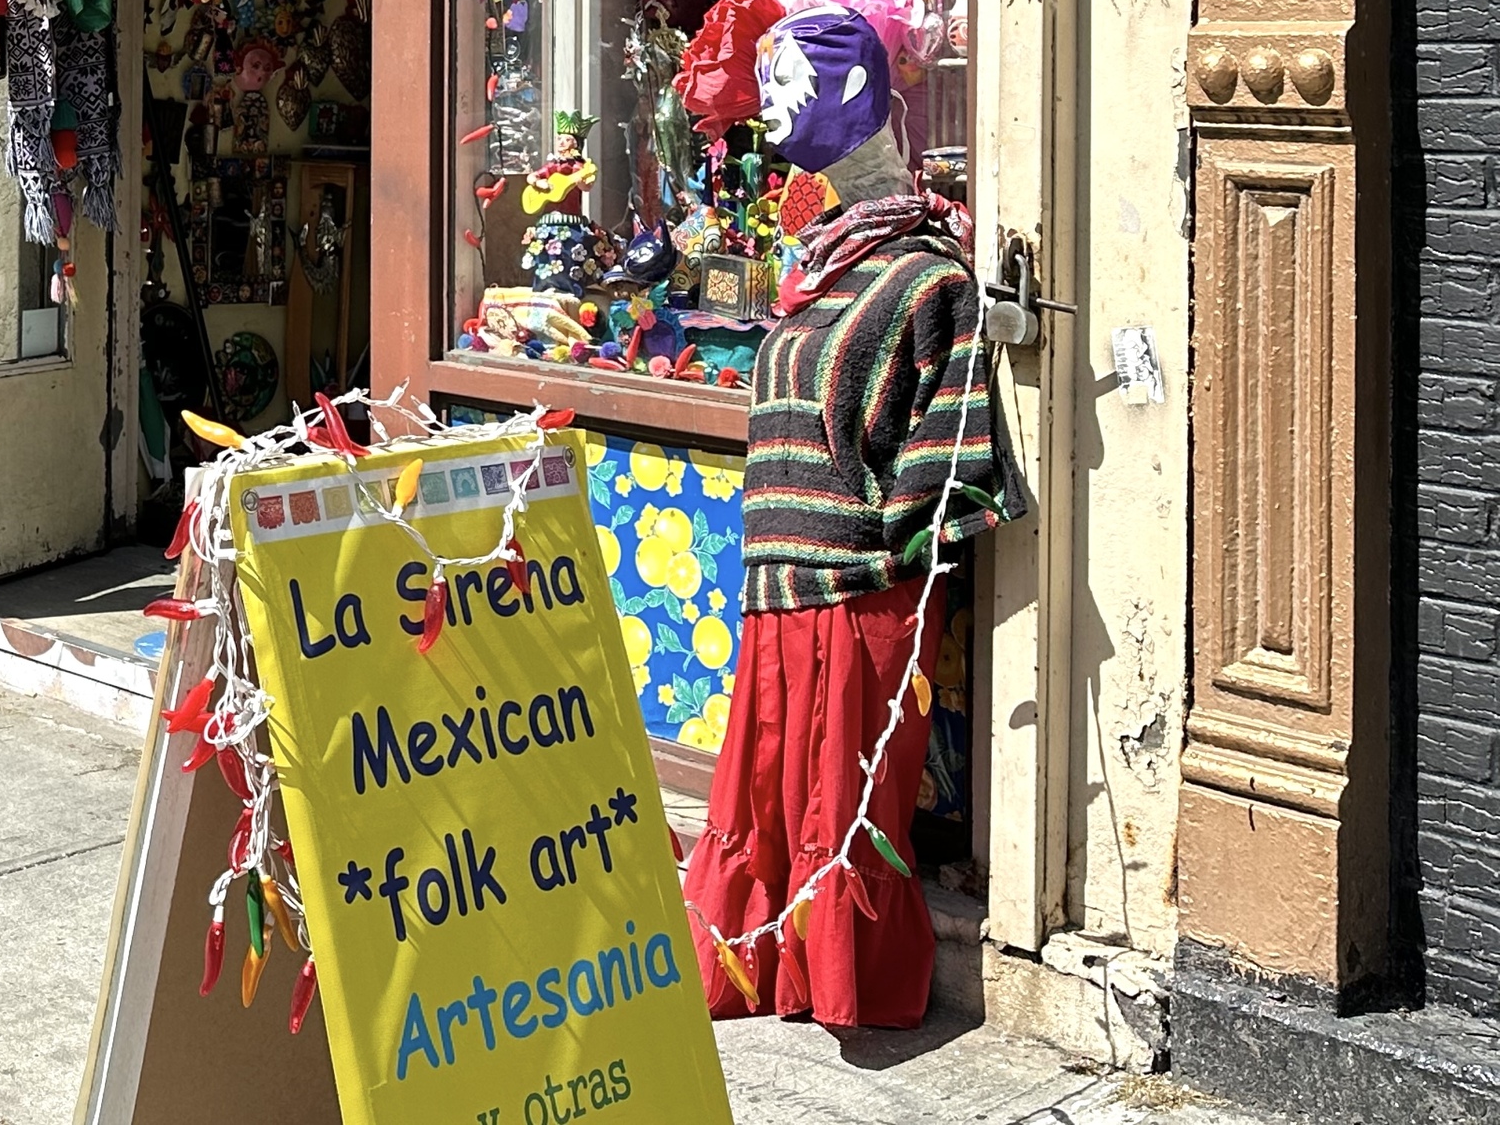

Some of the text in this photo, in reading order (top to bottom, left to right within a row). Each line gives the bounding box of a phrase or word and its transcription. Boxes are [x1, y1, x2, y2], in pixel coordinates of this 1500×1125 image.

[289, 578, 372, 659] La
[351, 685, 595, 795] Mexican
[395, 920, 681, 1081] Artesania
[524, 1059, 632, 1125] otras
